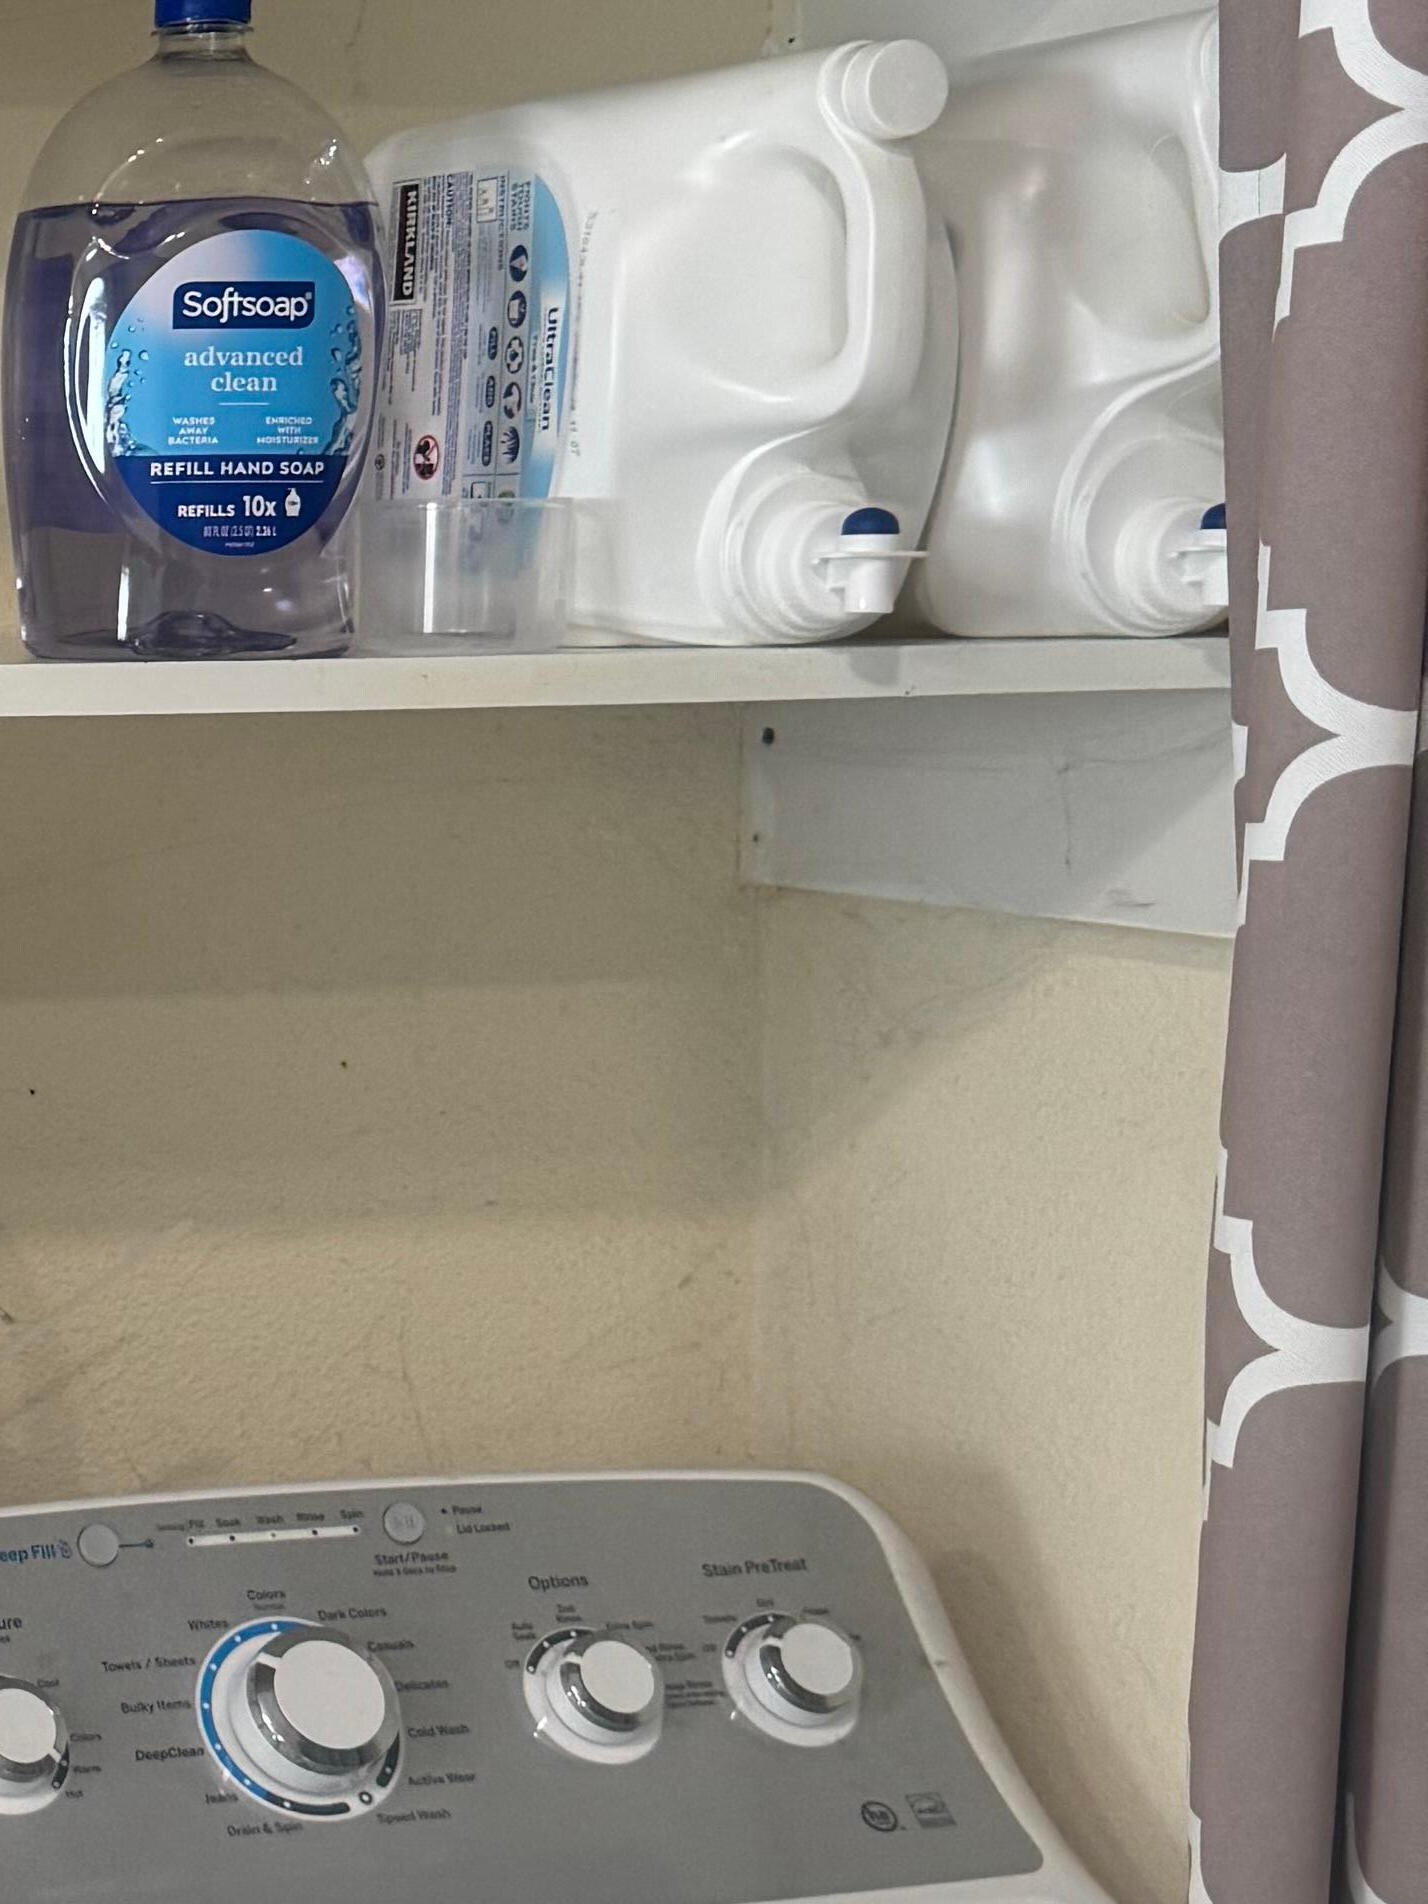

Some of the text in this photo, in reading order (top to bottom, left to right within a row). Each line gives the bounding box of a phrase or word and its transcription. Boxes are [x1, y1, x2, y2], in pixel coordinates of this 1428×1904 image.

[402, 190, 418, 297] KIRKLAND
[182, 287, 310, 323] Softsoap
[184, 346, 303, 366] advanced
[541, 307, 558, 431] UltraClean
[211, 373, 277, 392] clean
[173, 417, 216, 425] WASHES
[168, 436, 218, 444] BACTERIA
[179, 427, 208, 435] AWAY
[278, 427, 301, 435] WITH
[151, 463, 324, 475] REFILL HAND SOAP
[178, 496, 276, 517] REFILLS 10x
[702, 1558, 807, 1577] Stain PreTreat
[528, 1574, 589, 1591] Options
[135, 1746, 205, 1763] DeepClean
